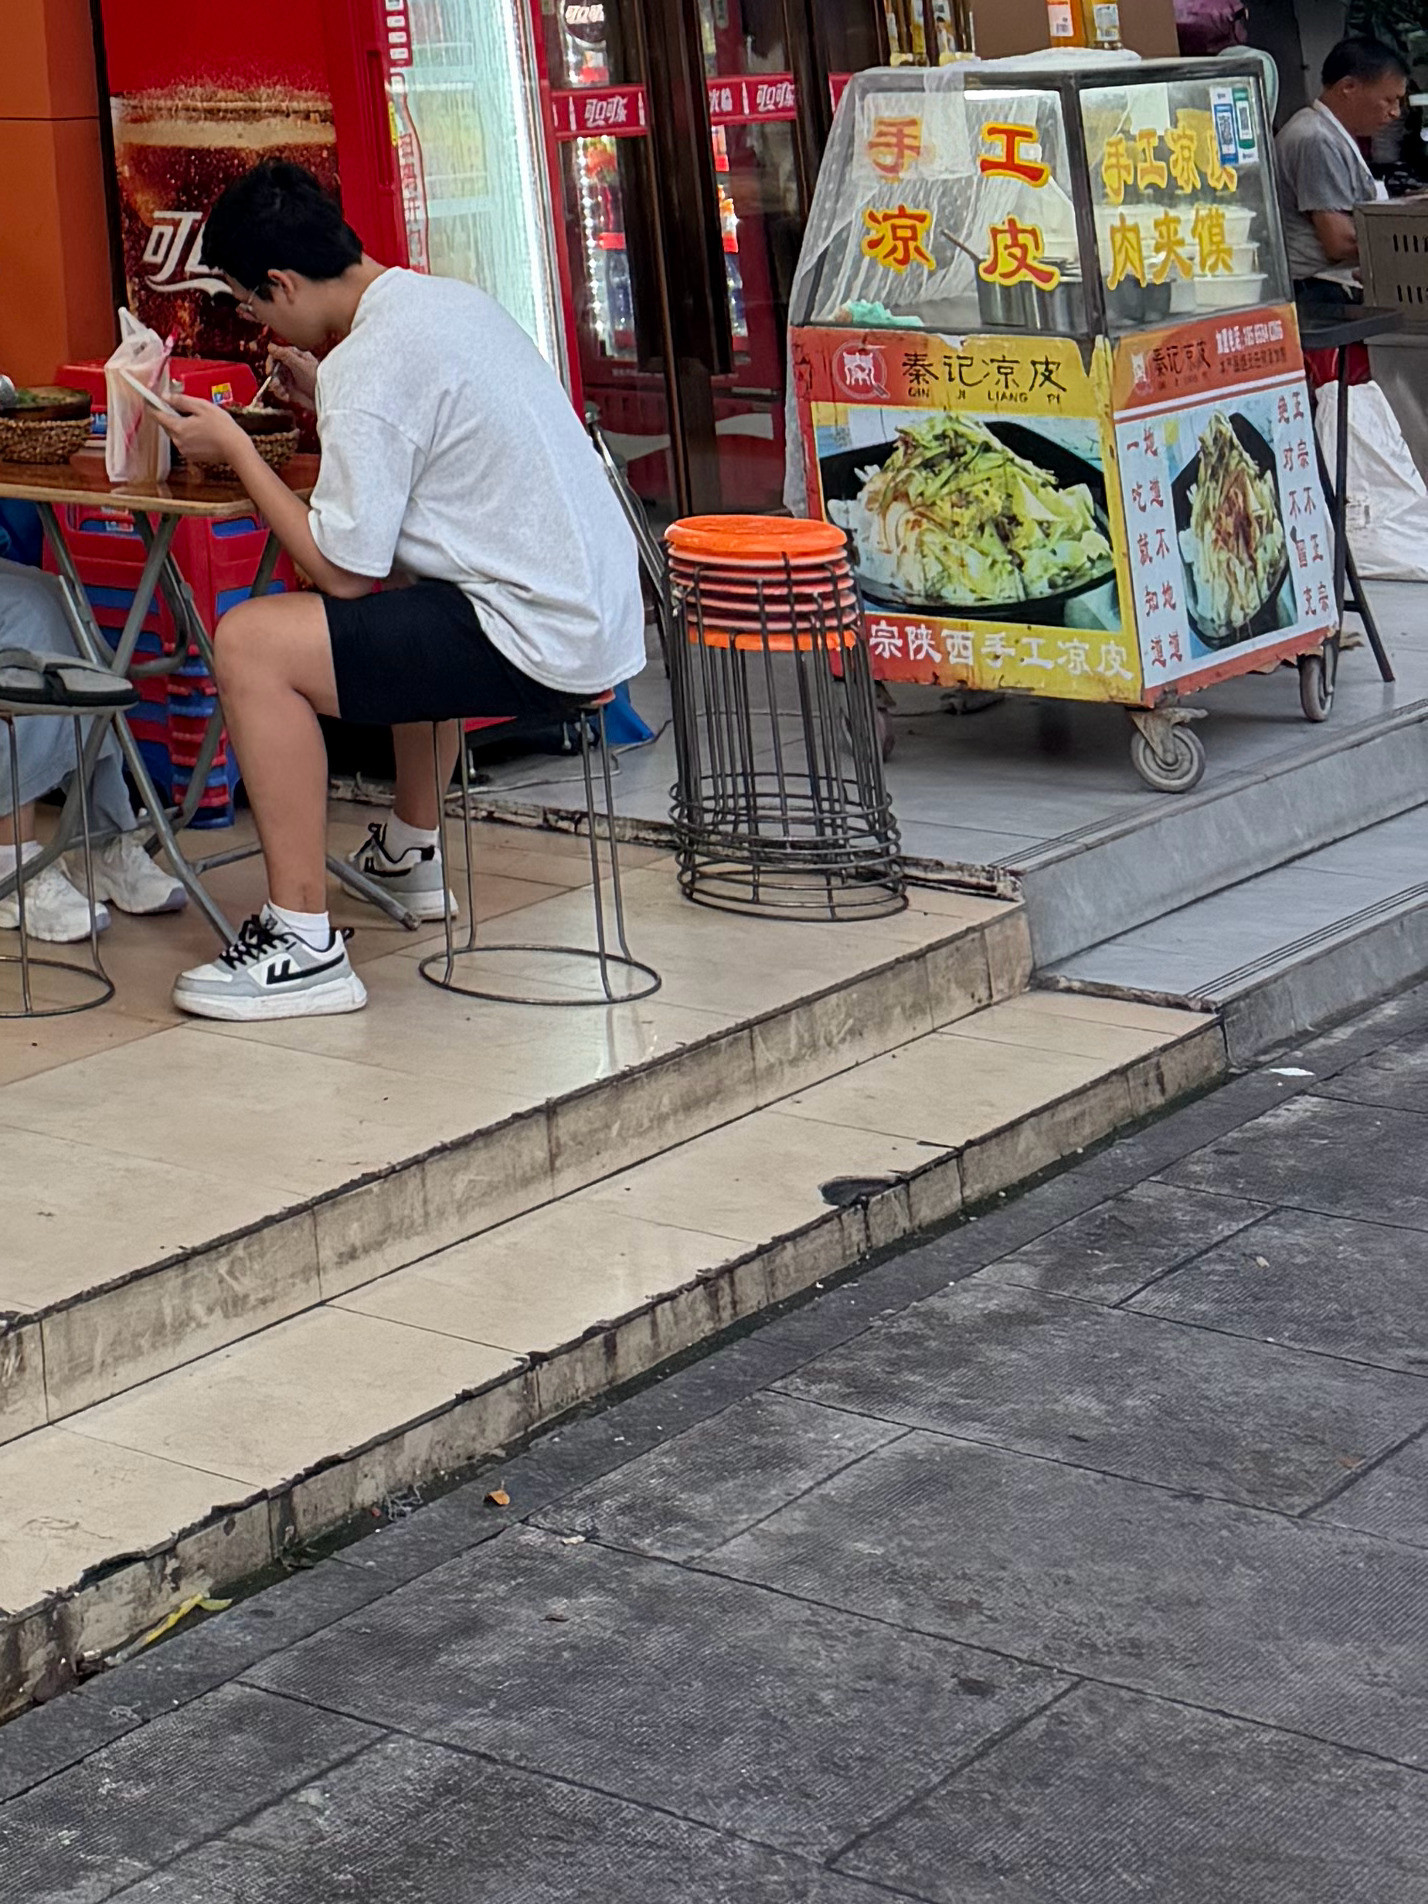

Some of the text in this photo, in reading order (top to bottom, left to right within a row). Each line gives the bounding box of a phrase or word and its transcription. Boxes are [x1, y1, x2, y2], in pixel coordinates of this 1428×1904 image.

[1107, 202, 1235, 291] 肉夹馍
[901, 350, 1067, 393] 秦记凉皮
